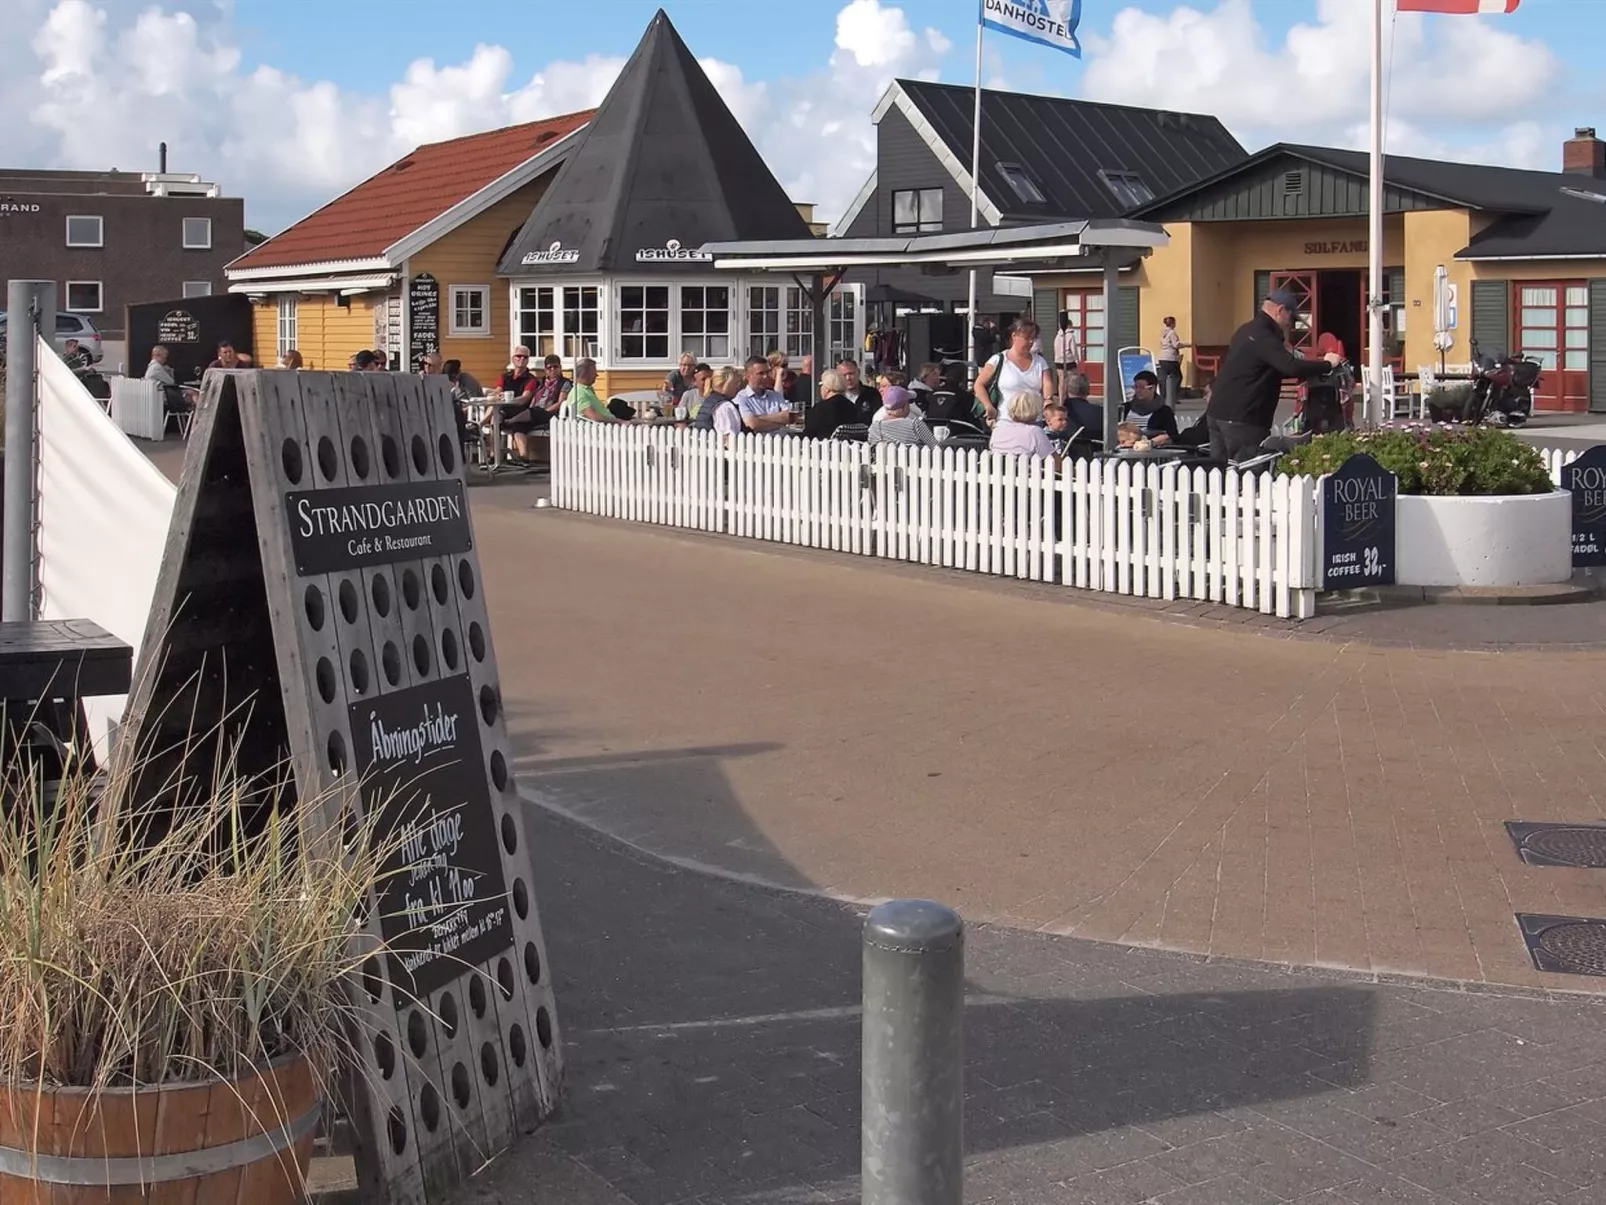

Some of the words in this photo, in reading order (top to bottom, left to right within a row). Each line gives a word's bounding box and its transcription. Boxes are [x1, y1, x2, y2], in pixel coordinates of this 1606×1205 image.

[0, 203, 40, 212] RAND
[525, 249, 580, 262] ISHUSET
[1333, 477, 1387, 504] ROYAL
[1345, 502, 1379, 522] BEER
[347, 537, 372, 556] Cafe
[374, 539, 383, 552] &
[385, 534, 432, 551] Restaurant
[1332, 552, 1357, 564] IRISH
[1327, 564, 1361, 577] COFFEE
[369, 702, 459, 764] Åbningstider
